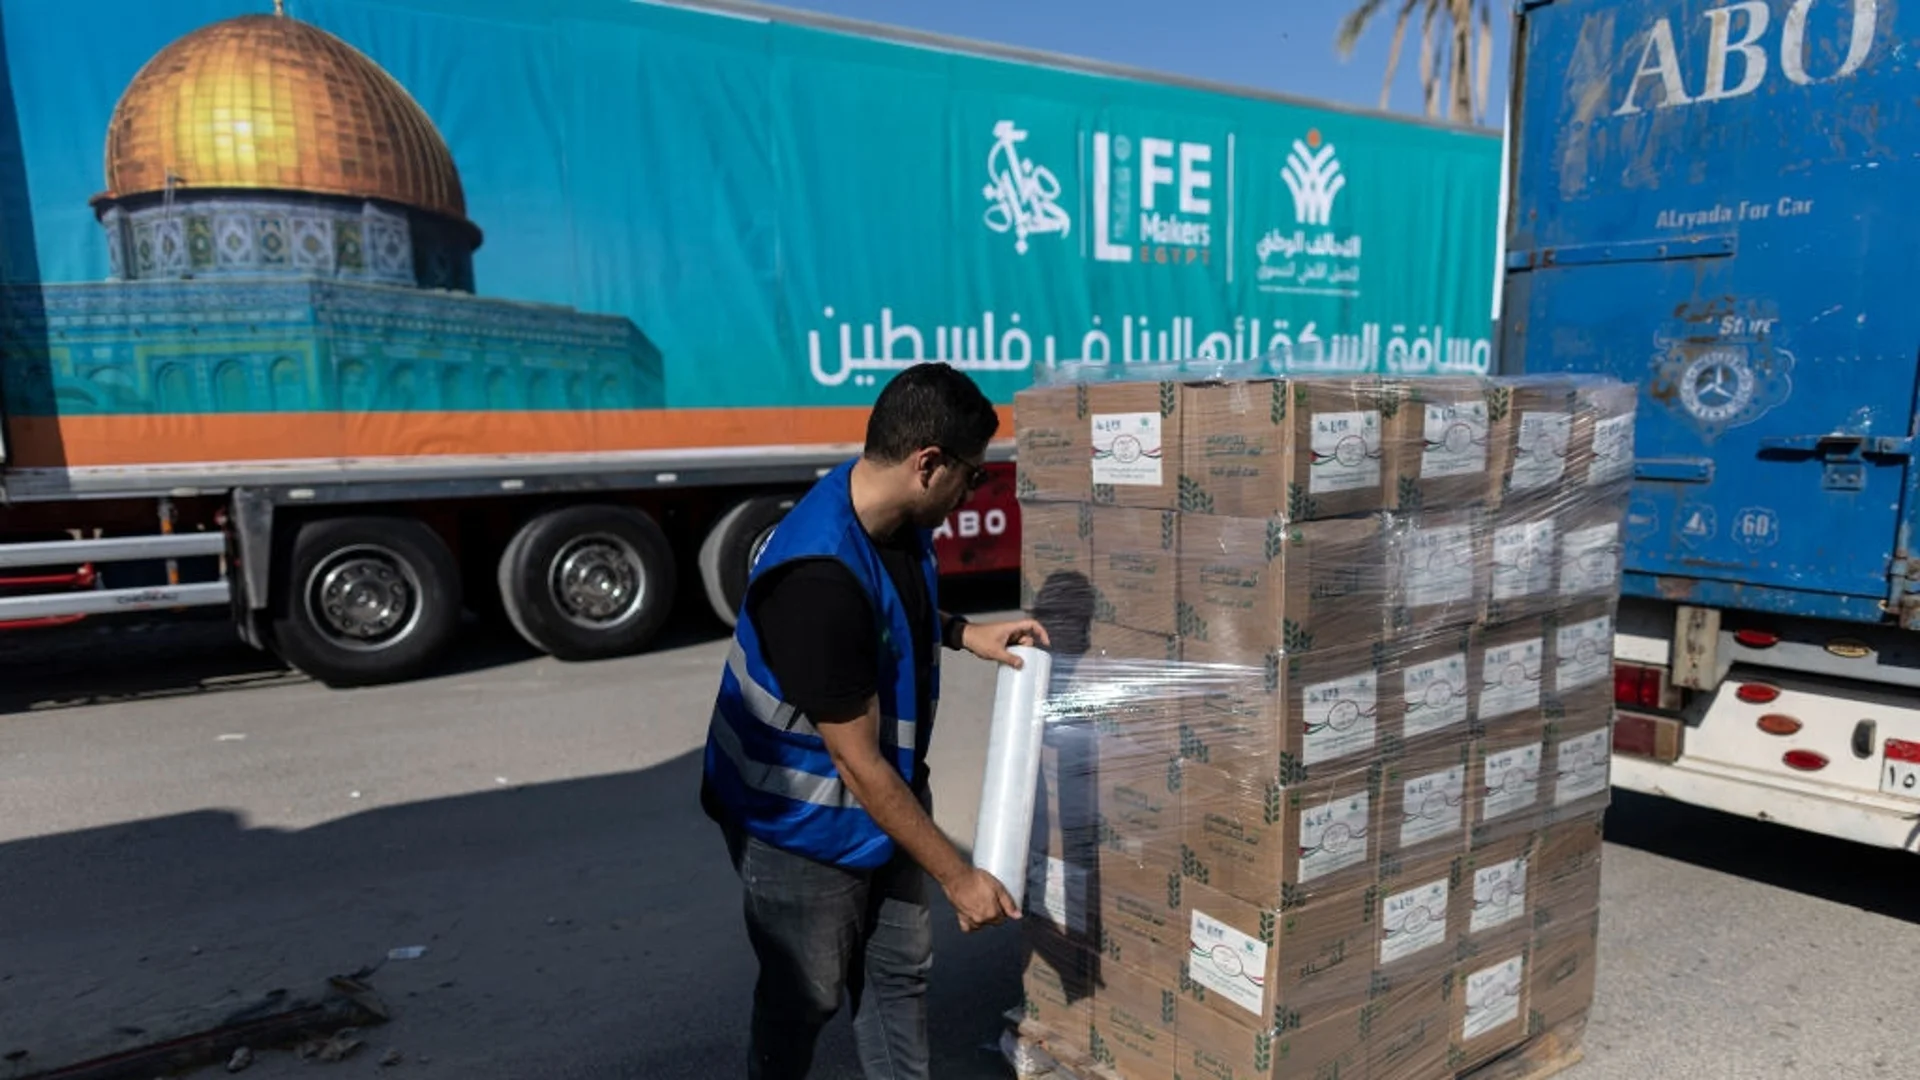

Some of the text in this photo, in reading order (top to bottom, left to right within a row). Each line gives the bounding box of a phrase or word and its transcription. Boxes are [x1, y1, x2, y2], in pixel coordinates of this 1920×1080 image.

[1612, 0, 1877, 116] ABO
[1776, 196, 1815, 217] Car
[1140, 211, 1211, 247] Makers
[1139, 245, 1212, 265] EGYPT
[807, 305, 1033, 387] فلسطين
[1268, 320, 1381, 375] السكة
[1387, 325, 1491, 375] مسافة
[931, 508, 1007, 540] ABO
[1742, 513, 1770, 537] 60
